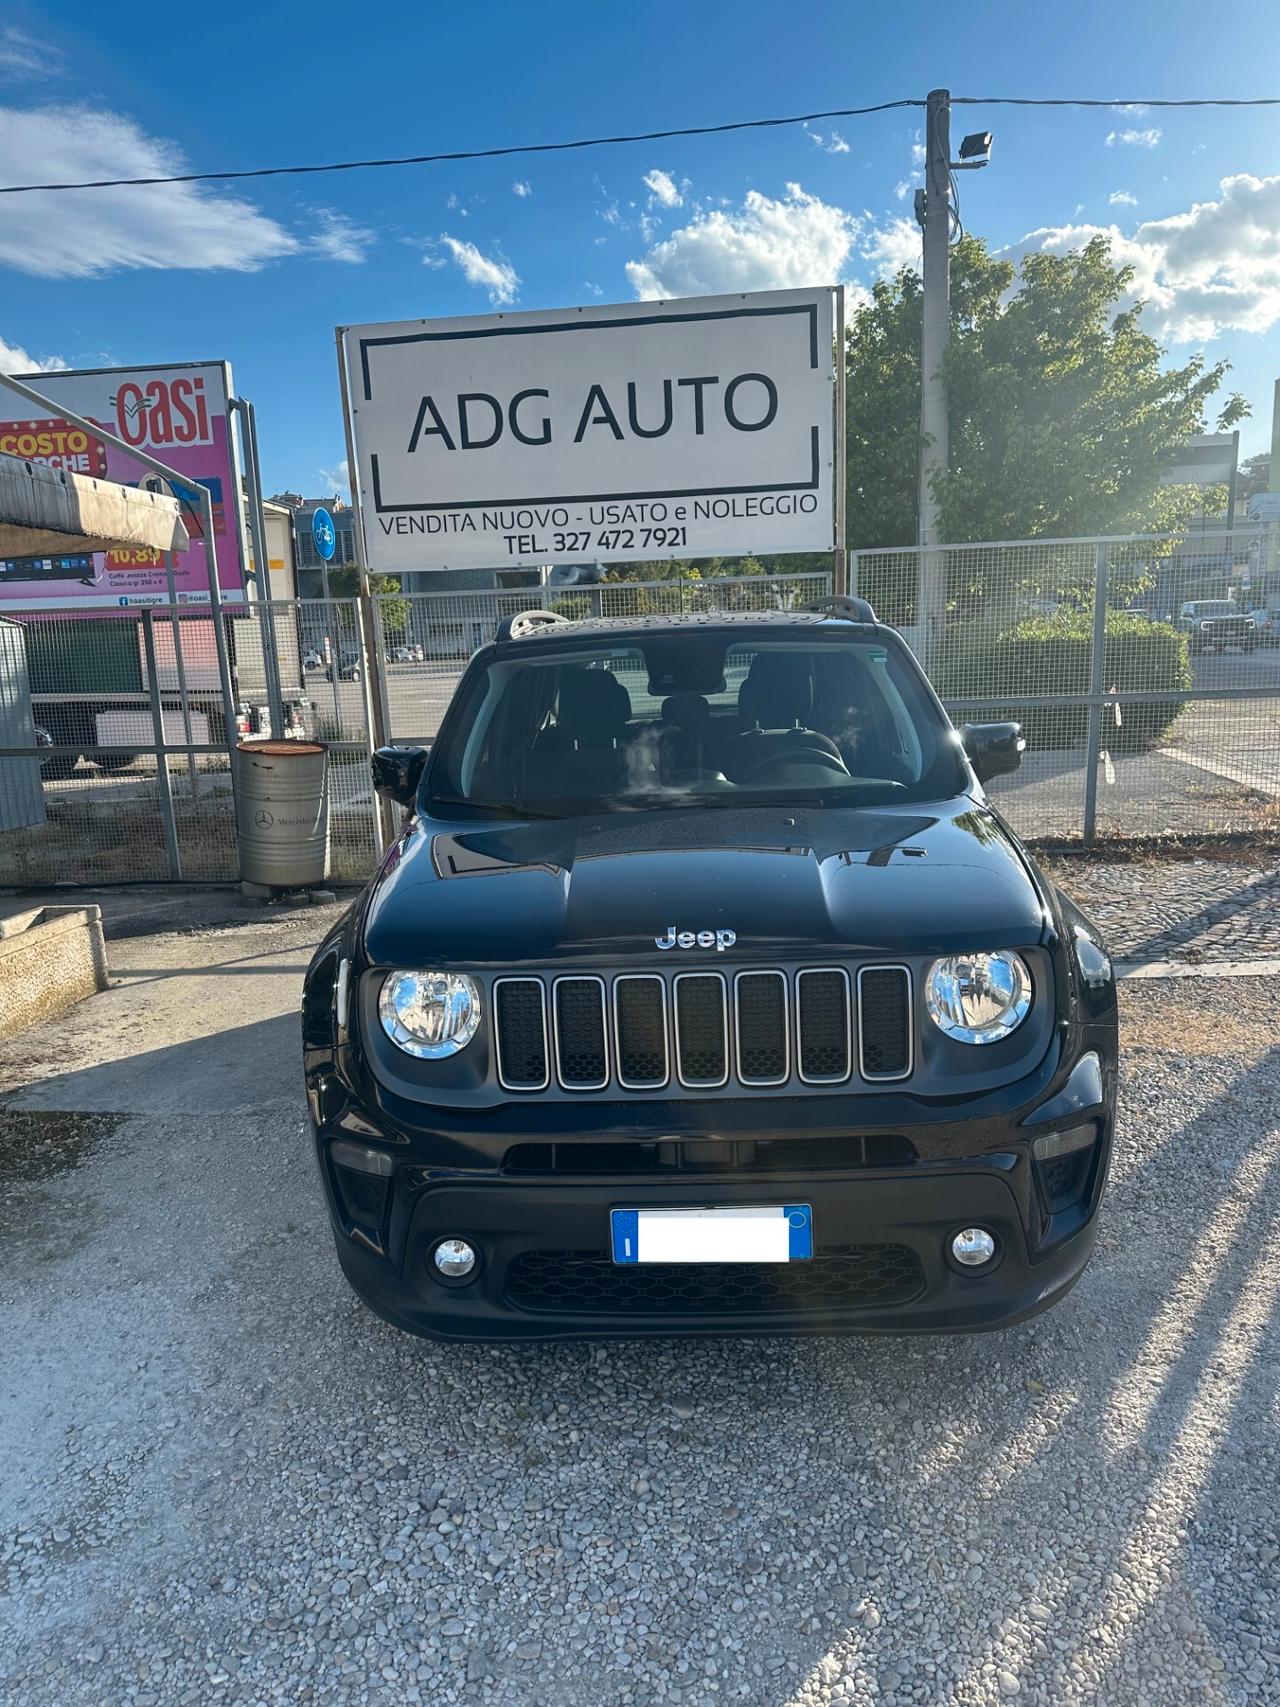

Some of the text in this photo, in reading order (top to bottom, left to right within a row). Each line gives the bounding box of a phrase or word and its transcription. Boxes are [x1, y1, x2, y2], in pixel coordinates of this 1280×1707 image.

[115, 377, 210, 446] Oasi
[407, 373, 778, 453] ADG AUTO
[0, 431, 88, 456] COSTO
[378, 513, 476, 535] VENDITA
[482, 508, 569, 530] NUOVO
[590, 503, 668, 525] USATO
[675, 506, 687, 520] e
[694, 494, 818, 520] NOLEGGIO
[504, 527, 687, 554] TEL. 327 472 7921
[655, 926, 737, 951] Jeep
